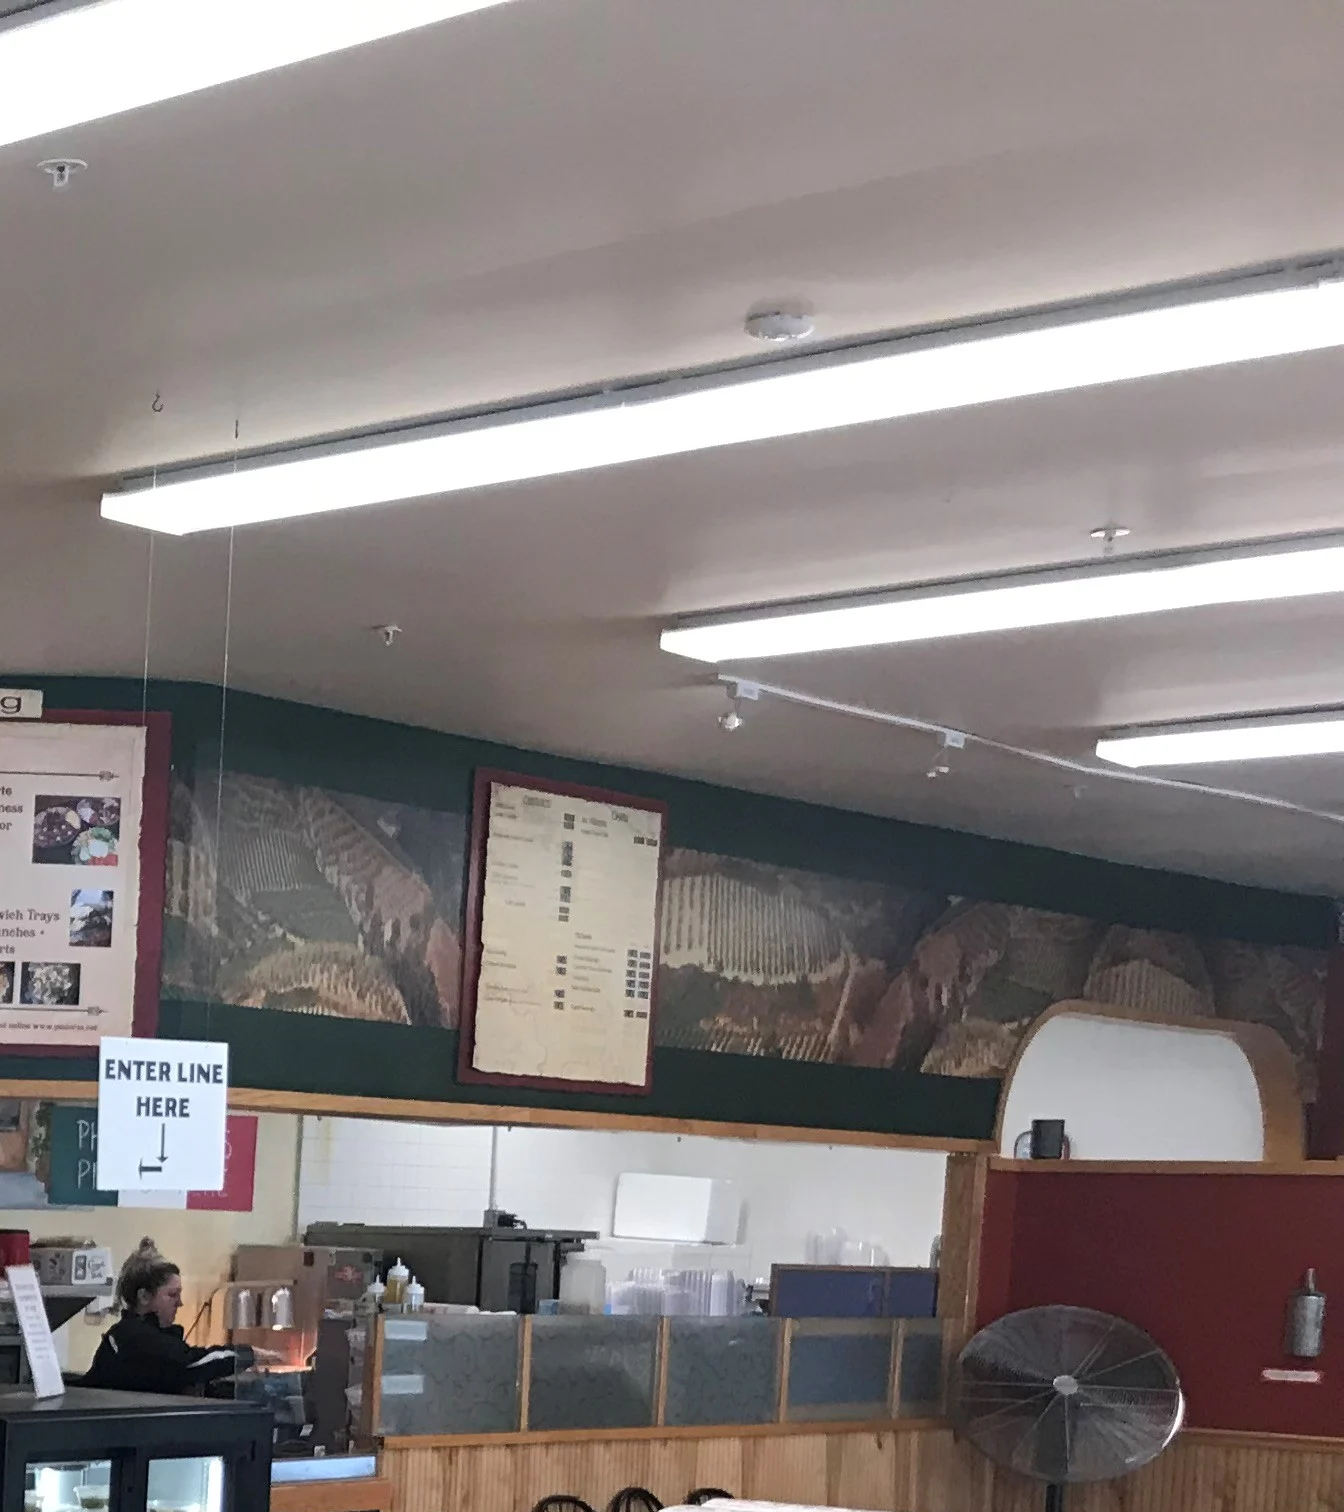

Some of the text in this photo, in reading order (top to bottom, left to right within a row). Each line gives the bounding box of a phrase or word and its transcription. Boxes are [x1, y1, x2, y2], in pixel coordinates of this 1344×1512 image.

[0, 821, 12, 830] or
[27, 909, 60, 923] Trays
[105, 1059, 223, 1084] ENTER LINE
[136, 1096, 190, 1118] HERE
